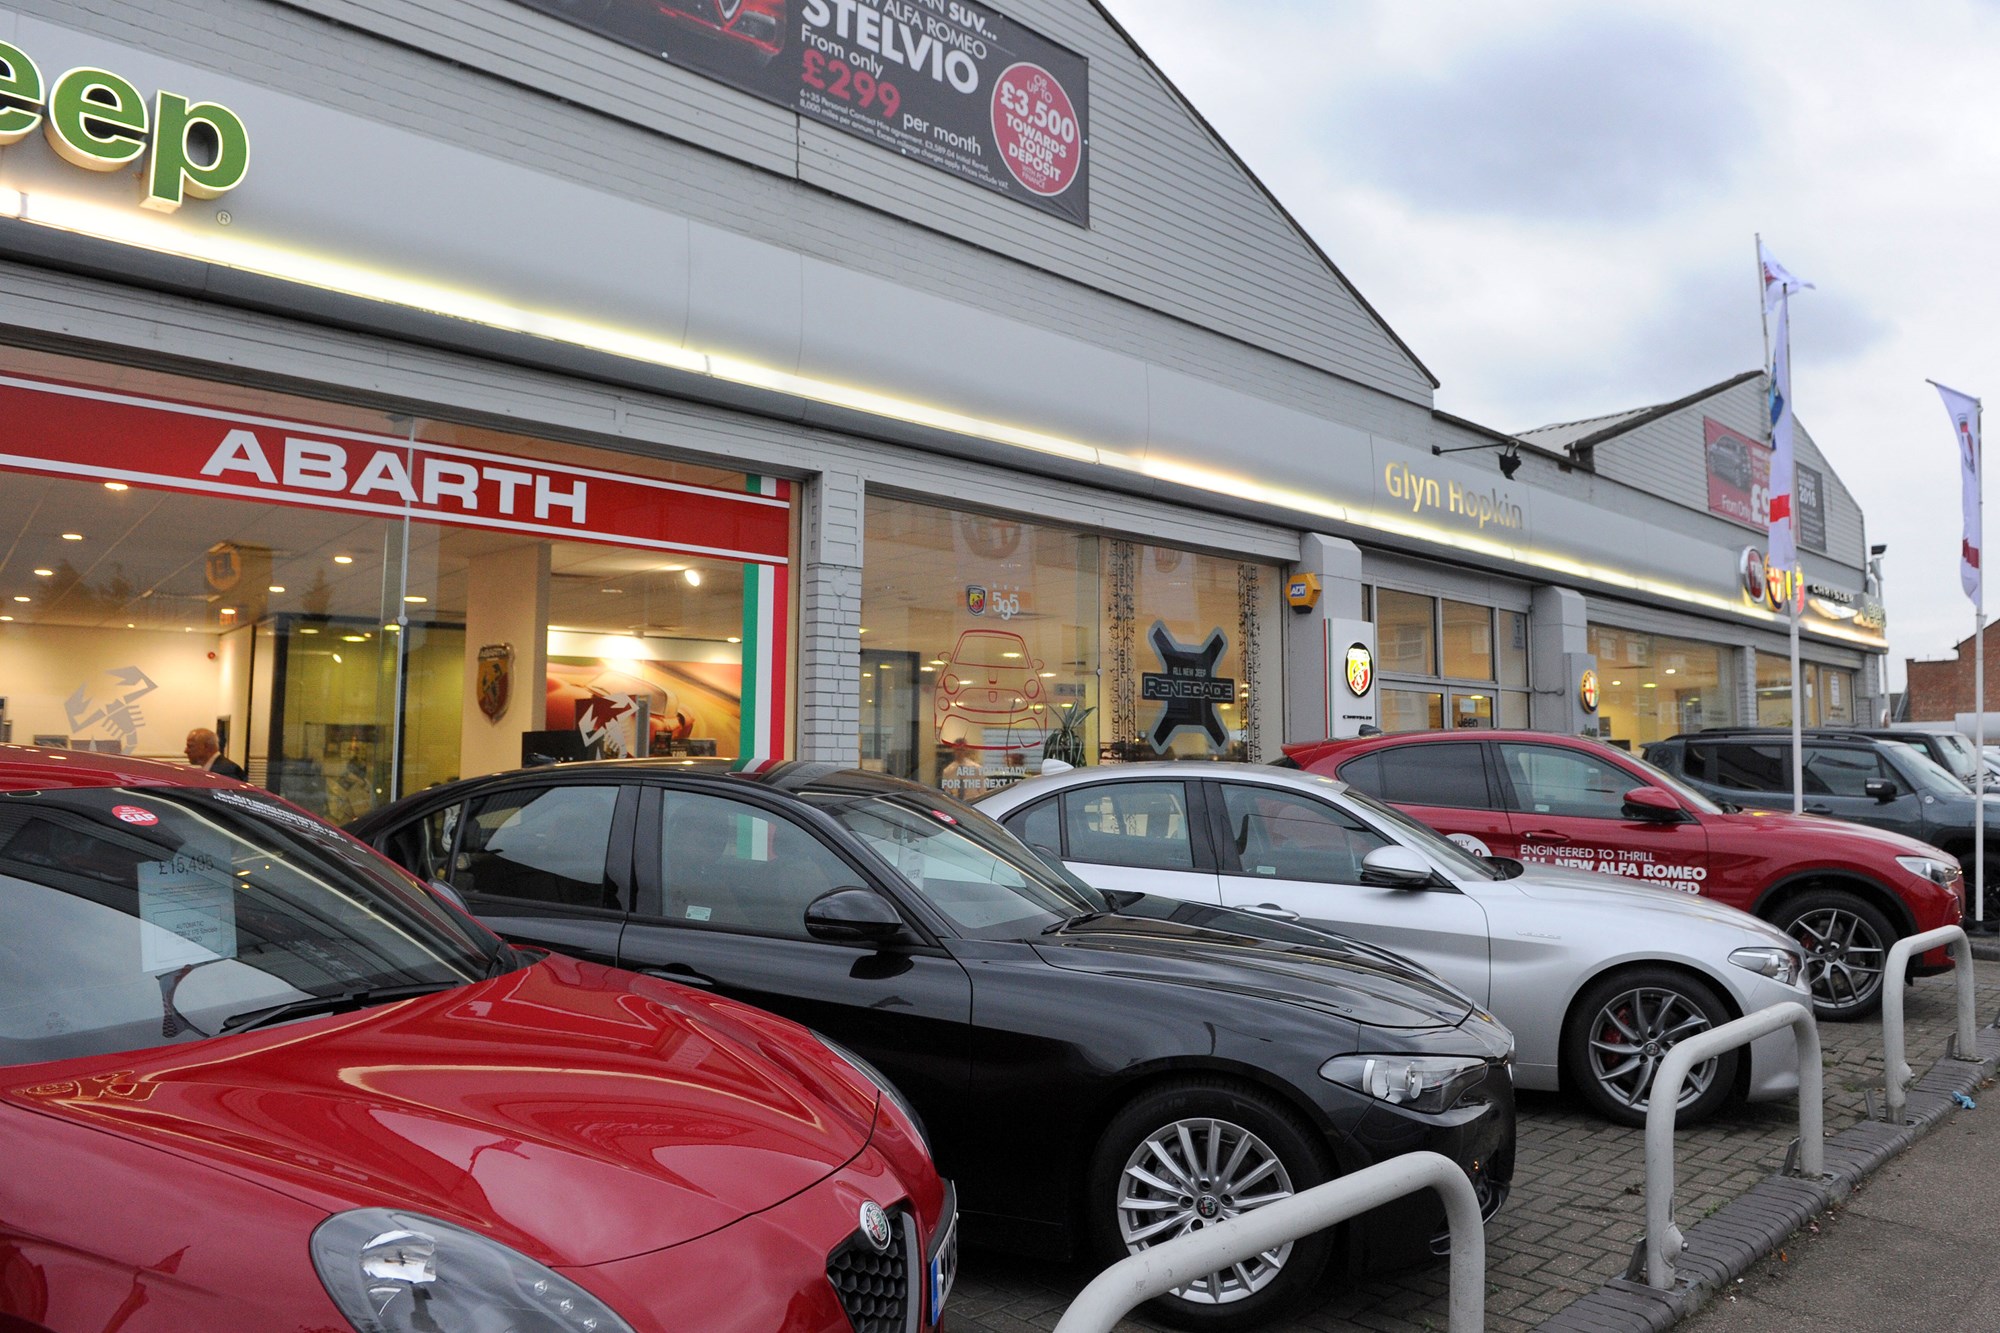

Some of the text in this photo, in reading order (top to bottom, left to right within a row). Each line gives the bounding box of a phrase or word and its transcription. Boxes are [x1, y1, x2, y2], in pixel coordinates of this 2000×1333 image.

[883, 0, 987, 60] ALFA ROMEO
[801, 24, 884, 79] From only
[802, 0, 979, 94] STELVIO
[802, 49, 902, 119] £299
[1041, 89, 1053, 103] TO
[821, 96, 848, 115] Personal
[849, 108, 876, 126] Contract
[877, 119, 890, 132] Hire
[821, 108, 839, 121] miles
[839, 116, 851, 126] per
[1001, 81, 1075, 144] £3,500
[903, 113, 981, 156] per month
[1006, 113, 1067, 158] TOWARDS
[1018, 134, 1054, 164] YOUR
[1008, 142, 1061, 182] DEPOSIT
[200, 428, 588, 525] ABARTH
[1385, 460, 1523, 530] Glyn Hopkin
[1290, 584, 1306, 597] ADT
[992, 591, 1020, 621] 595
[1143, 676, 1234, 701] RENEGADE
[941, 779, 960, 789] FOR
[963, 779, 981, 789] THE
[983, 778, 1008, 789] NEXT
[956, 767, 975, 777] ARE
[120, 813, 156, 823] GAP
[158, 854, 214, 875] £15,495
[1520, 844, 1655, 862] ENGINEERED TO THRILL
[1597, 861, 1639, 876] ALFA
[1643, 864, 1707, 881] ROMEO
